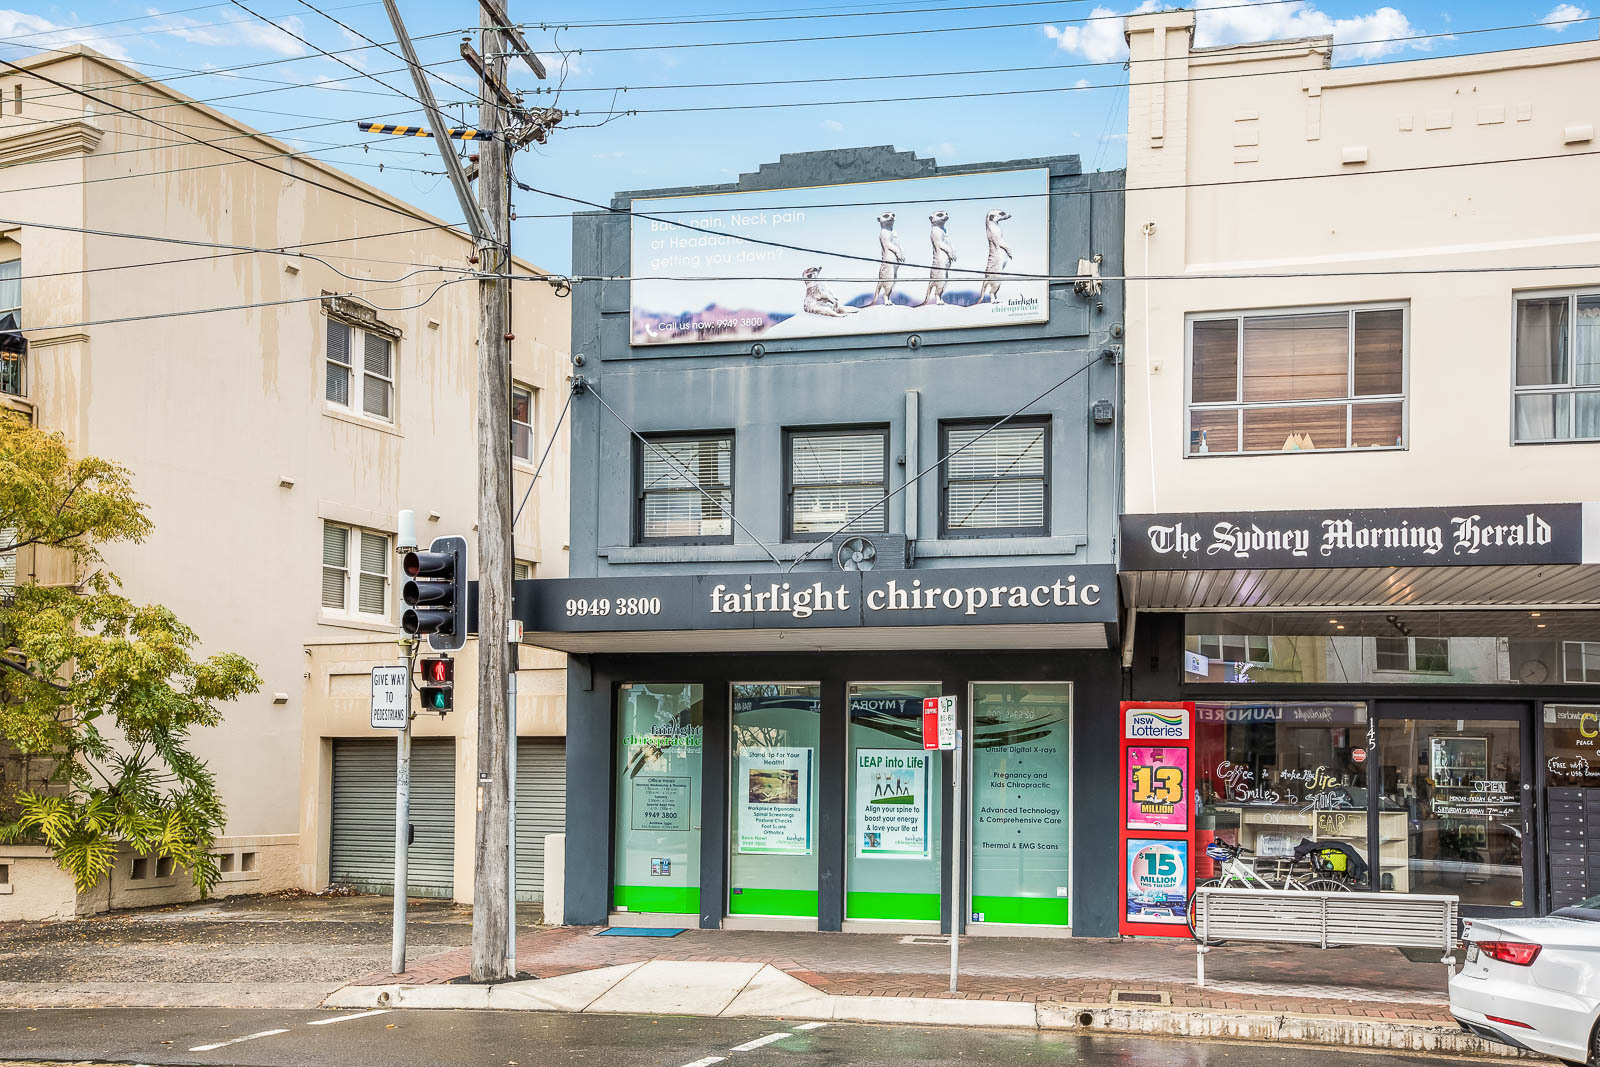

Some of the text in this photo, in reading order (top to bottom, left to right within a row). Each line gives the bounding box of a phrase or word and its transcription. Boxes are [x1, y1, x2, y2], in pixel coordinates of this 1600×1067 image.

[731, 214, 768, 226] Neck
[772, 210, 805, 225] pain
[651, 240, 665, 250] or
[651, 249, 783, 270] getting you down?
[658, 322, 676, 331] Call
[718, 319, 738, 328] 9949
[740, 318, 762, 327] 3800
[1147, 513, 1552, 559] The Sydney Morning Herald
[565, 575, 1100, 618] 9949 3800 fairlight chiropractic
[374, 674, 406, 686] GIVE WAY
[386, 692, 394, 702] TO
[374, 708, 404, 720] PEDESTRIANS
[652, 724, 700, 736] fairlight
[1132, 724, 1182, 736] Lotteries
[623, 735, 702, 748] chiropractic
[860, 756, 924, 768] LEAP into Life
[1475, 781, 1506, 792] OPEN
[1284, 789, 1298, 804] to
[1141, 804, 1174, 814] MILLION
[1139, 853, 1176, 876] $15
